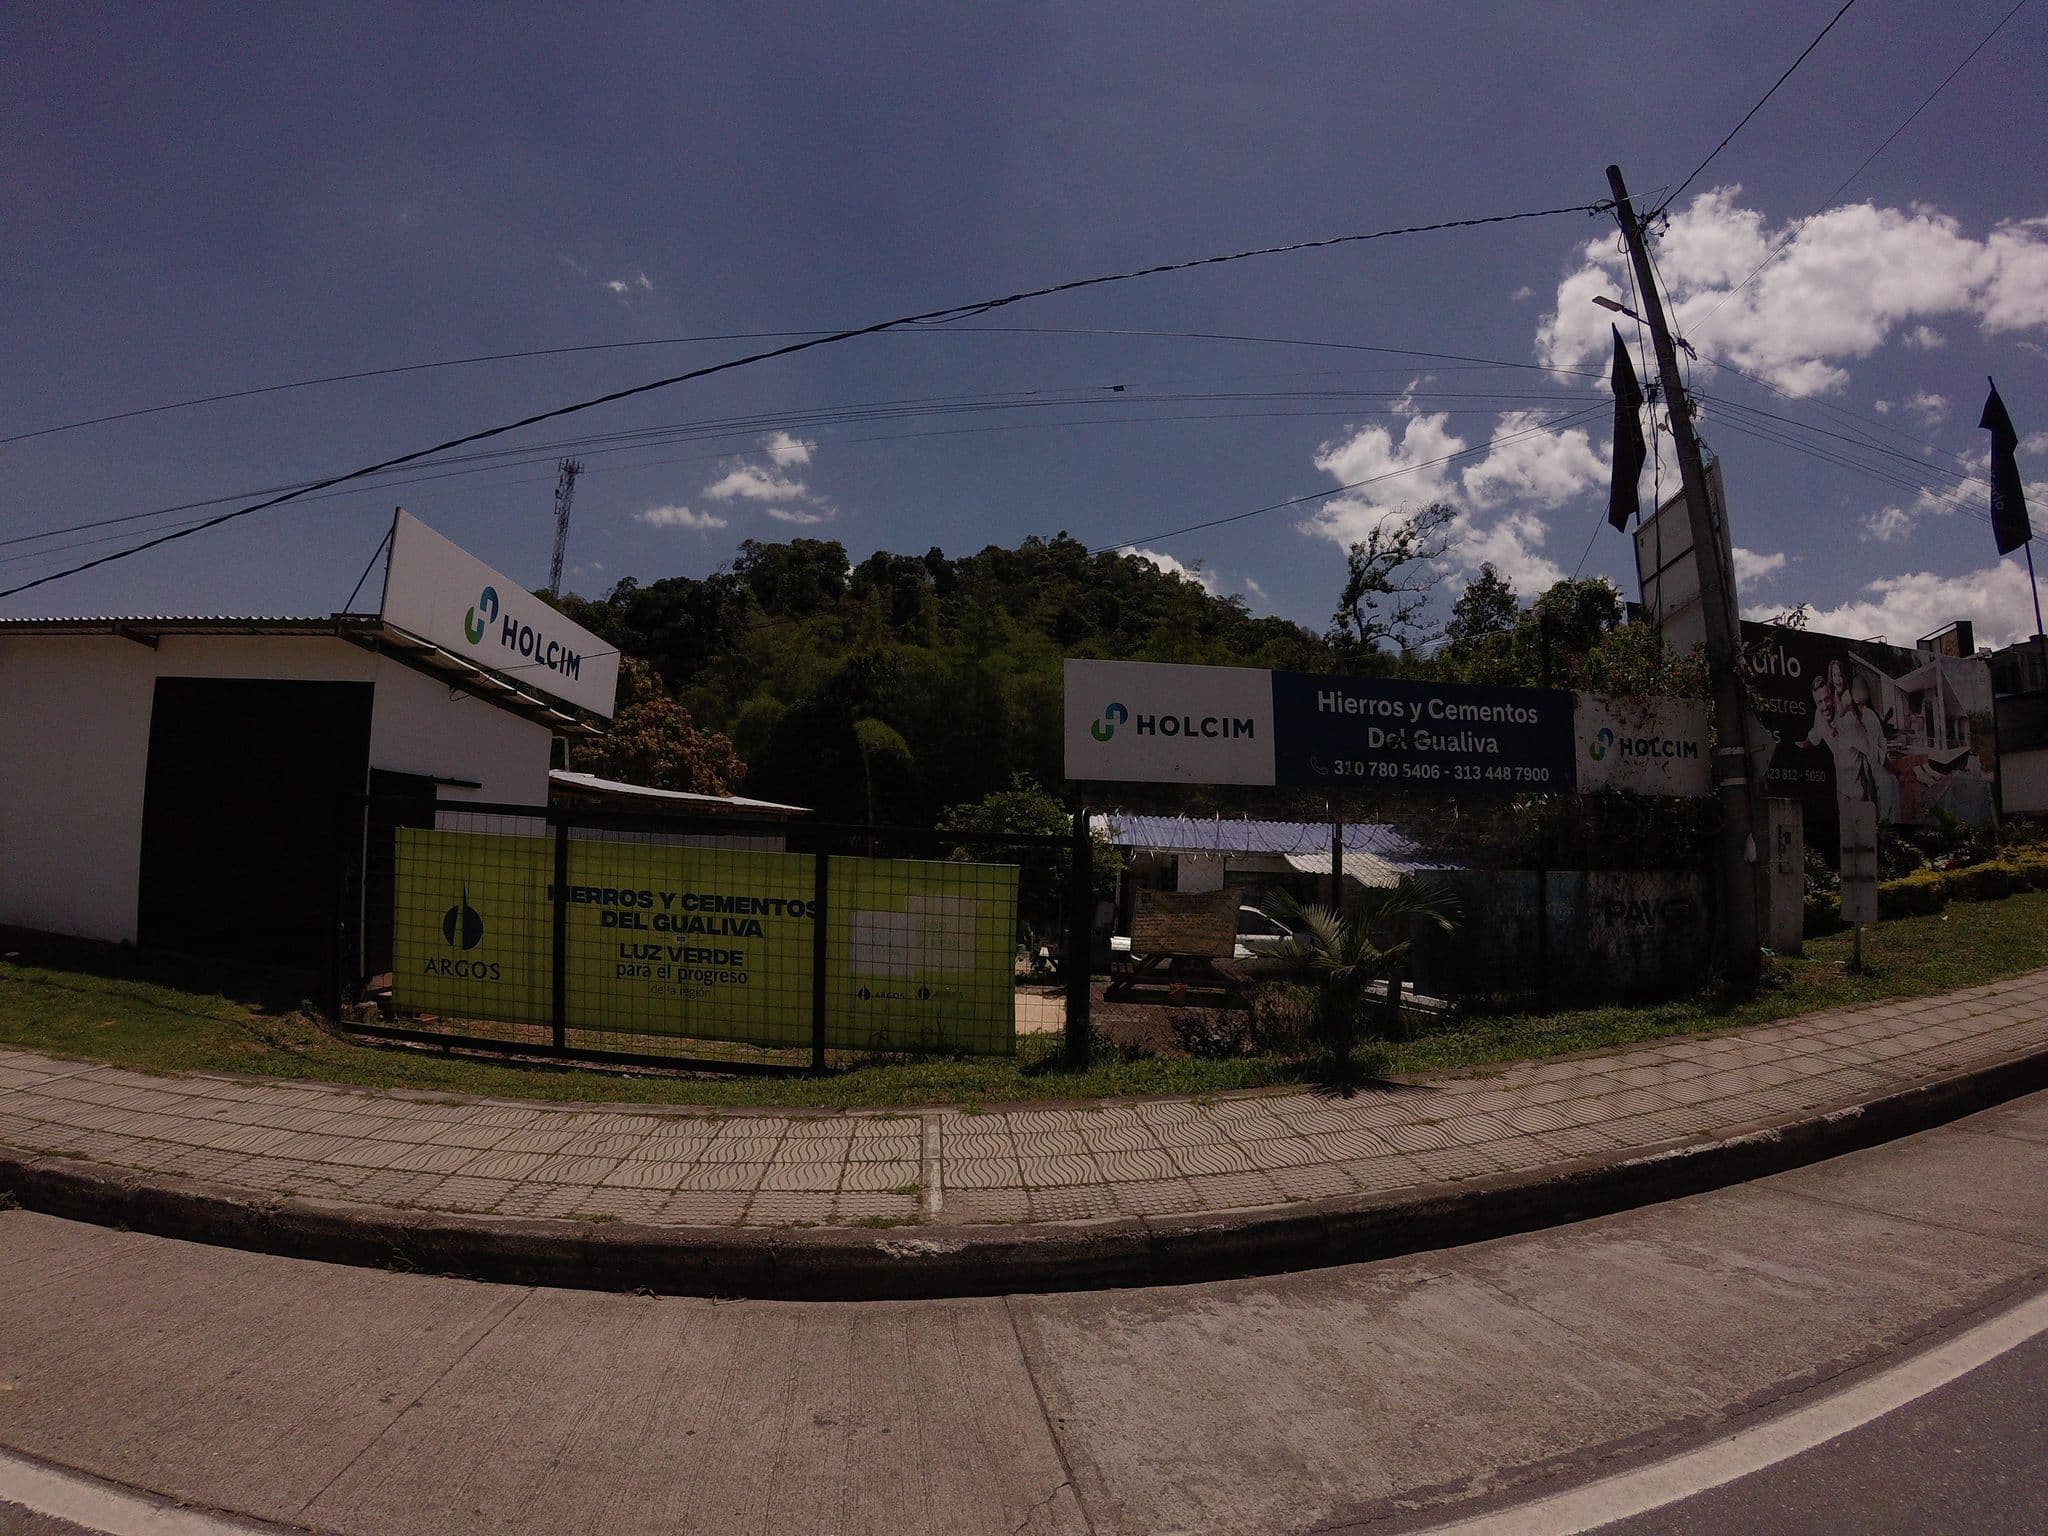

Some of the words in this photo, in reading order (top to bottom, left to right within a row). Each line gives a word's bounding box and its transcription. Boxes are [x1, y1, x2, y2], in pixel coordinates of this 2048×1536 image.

[501, 614, 581, 681] HOLCIM
[1317, 690, 1404, 717] Hierros
[1408, 702, 1422, 723] y
[1428, 698, 1538, 724] Cementos
[1136, 714, 1255, 739] HOLCIM
[1367, 727, 1408, 751] Del
[1413, 729, 1500, 753] Gualiva
[1620, 738, 1698, 759] HOLCIM
[1333, 760, 1364, 776] 310
[1369, 762, 1398, 777] 780
[1402, 763, 1440, 779] 5406
[1454, 765, 1481, 780] 313
[1485, 766, 1511, 781] 448
[1515, 766, 1550, 782] 7900
[659, 891, 677, 909] Y
[601, 910, 648, 930] DEL
[653, 913, 763, 938] GUALIVA
[619, 942, 662, 961] LUZ
[667, 945, 744, 967] VERDE
[424, 957, 501, 981] ARGOS
[616, 964, 652, 979] para
[657, 964, 671, 979] el
[678, 967, 748, 987] progreso
